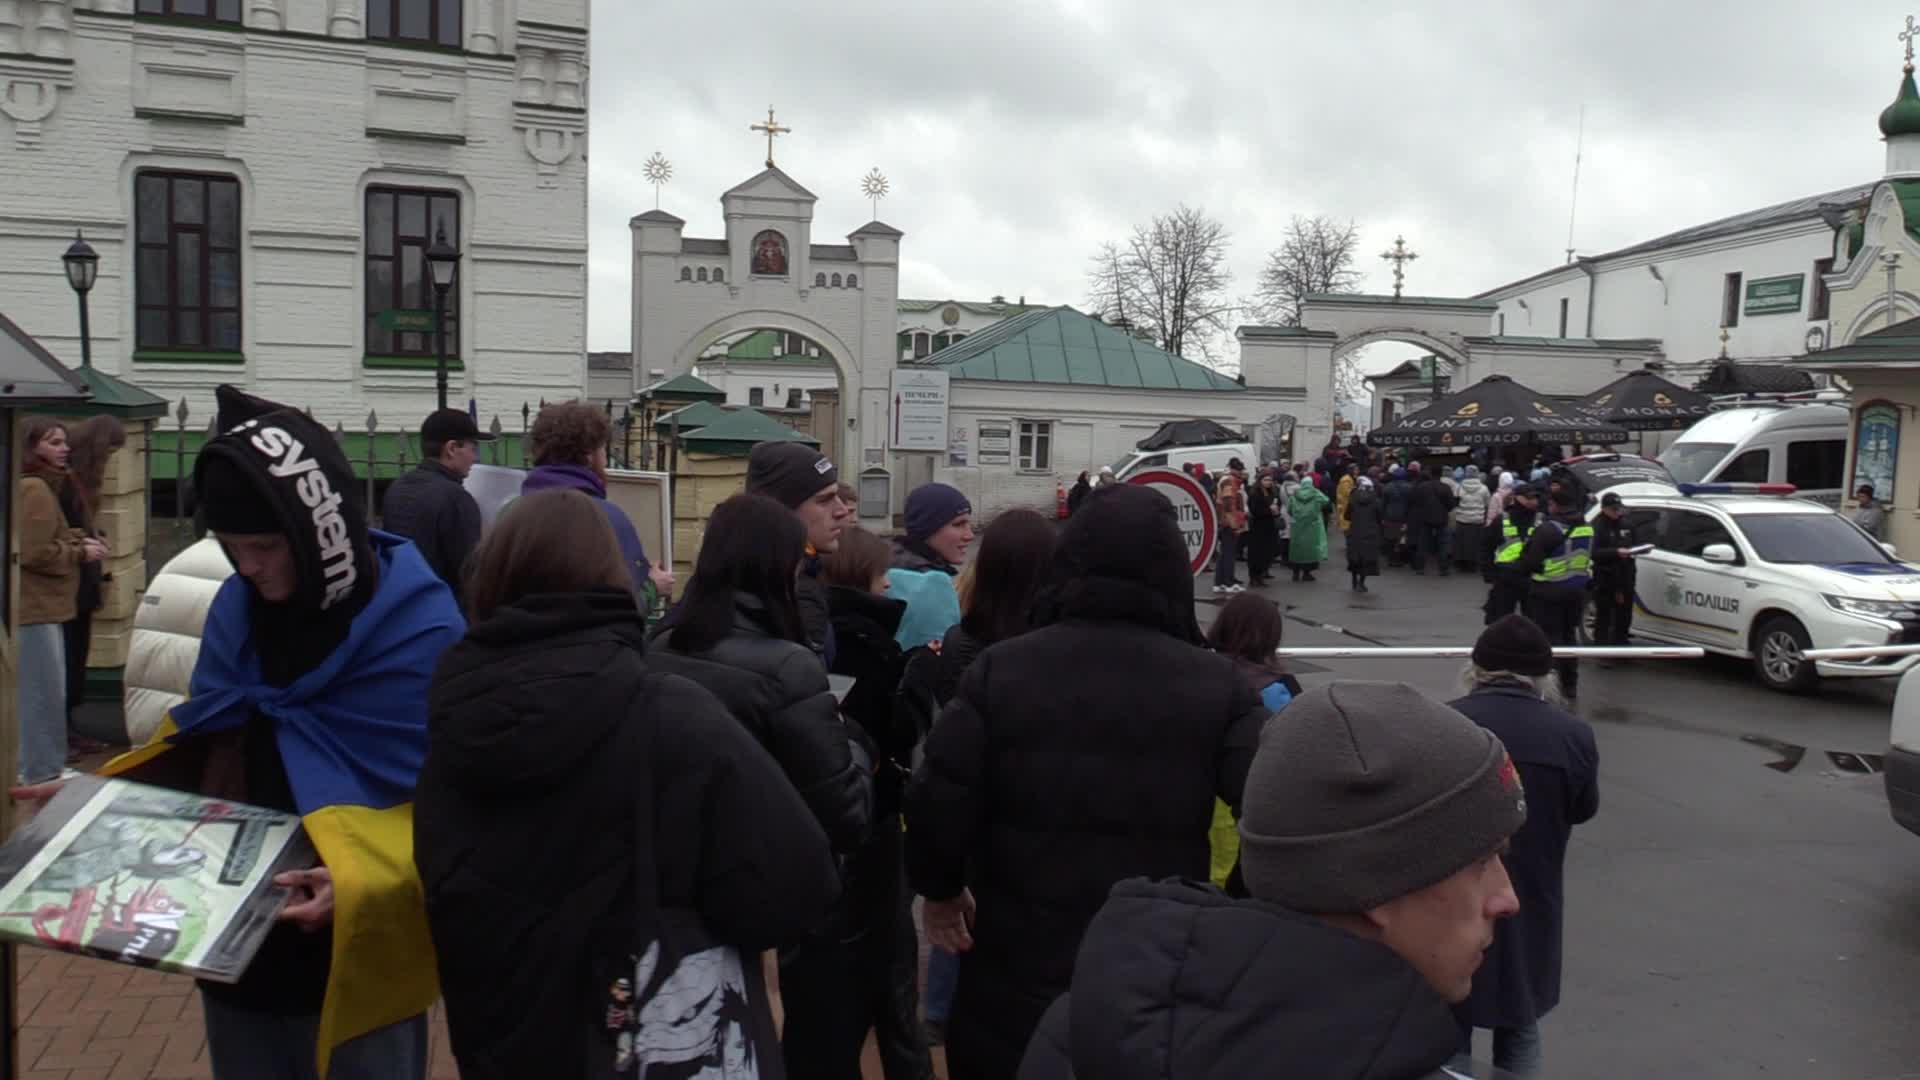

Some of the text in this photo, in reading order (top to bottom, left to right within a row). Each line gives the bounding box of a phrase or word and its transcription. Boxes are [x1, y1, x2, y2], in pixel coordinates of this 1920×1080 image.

[1623, 402, 1720, 416] MONACO
[1398, 416, 1515, 429] MONACO
[1373, 433, 1520, 445] MONACO MONACO
[1685, 590, 1740, 614] ПОЛІЦІЯ
